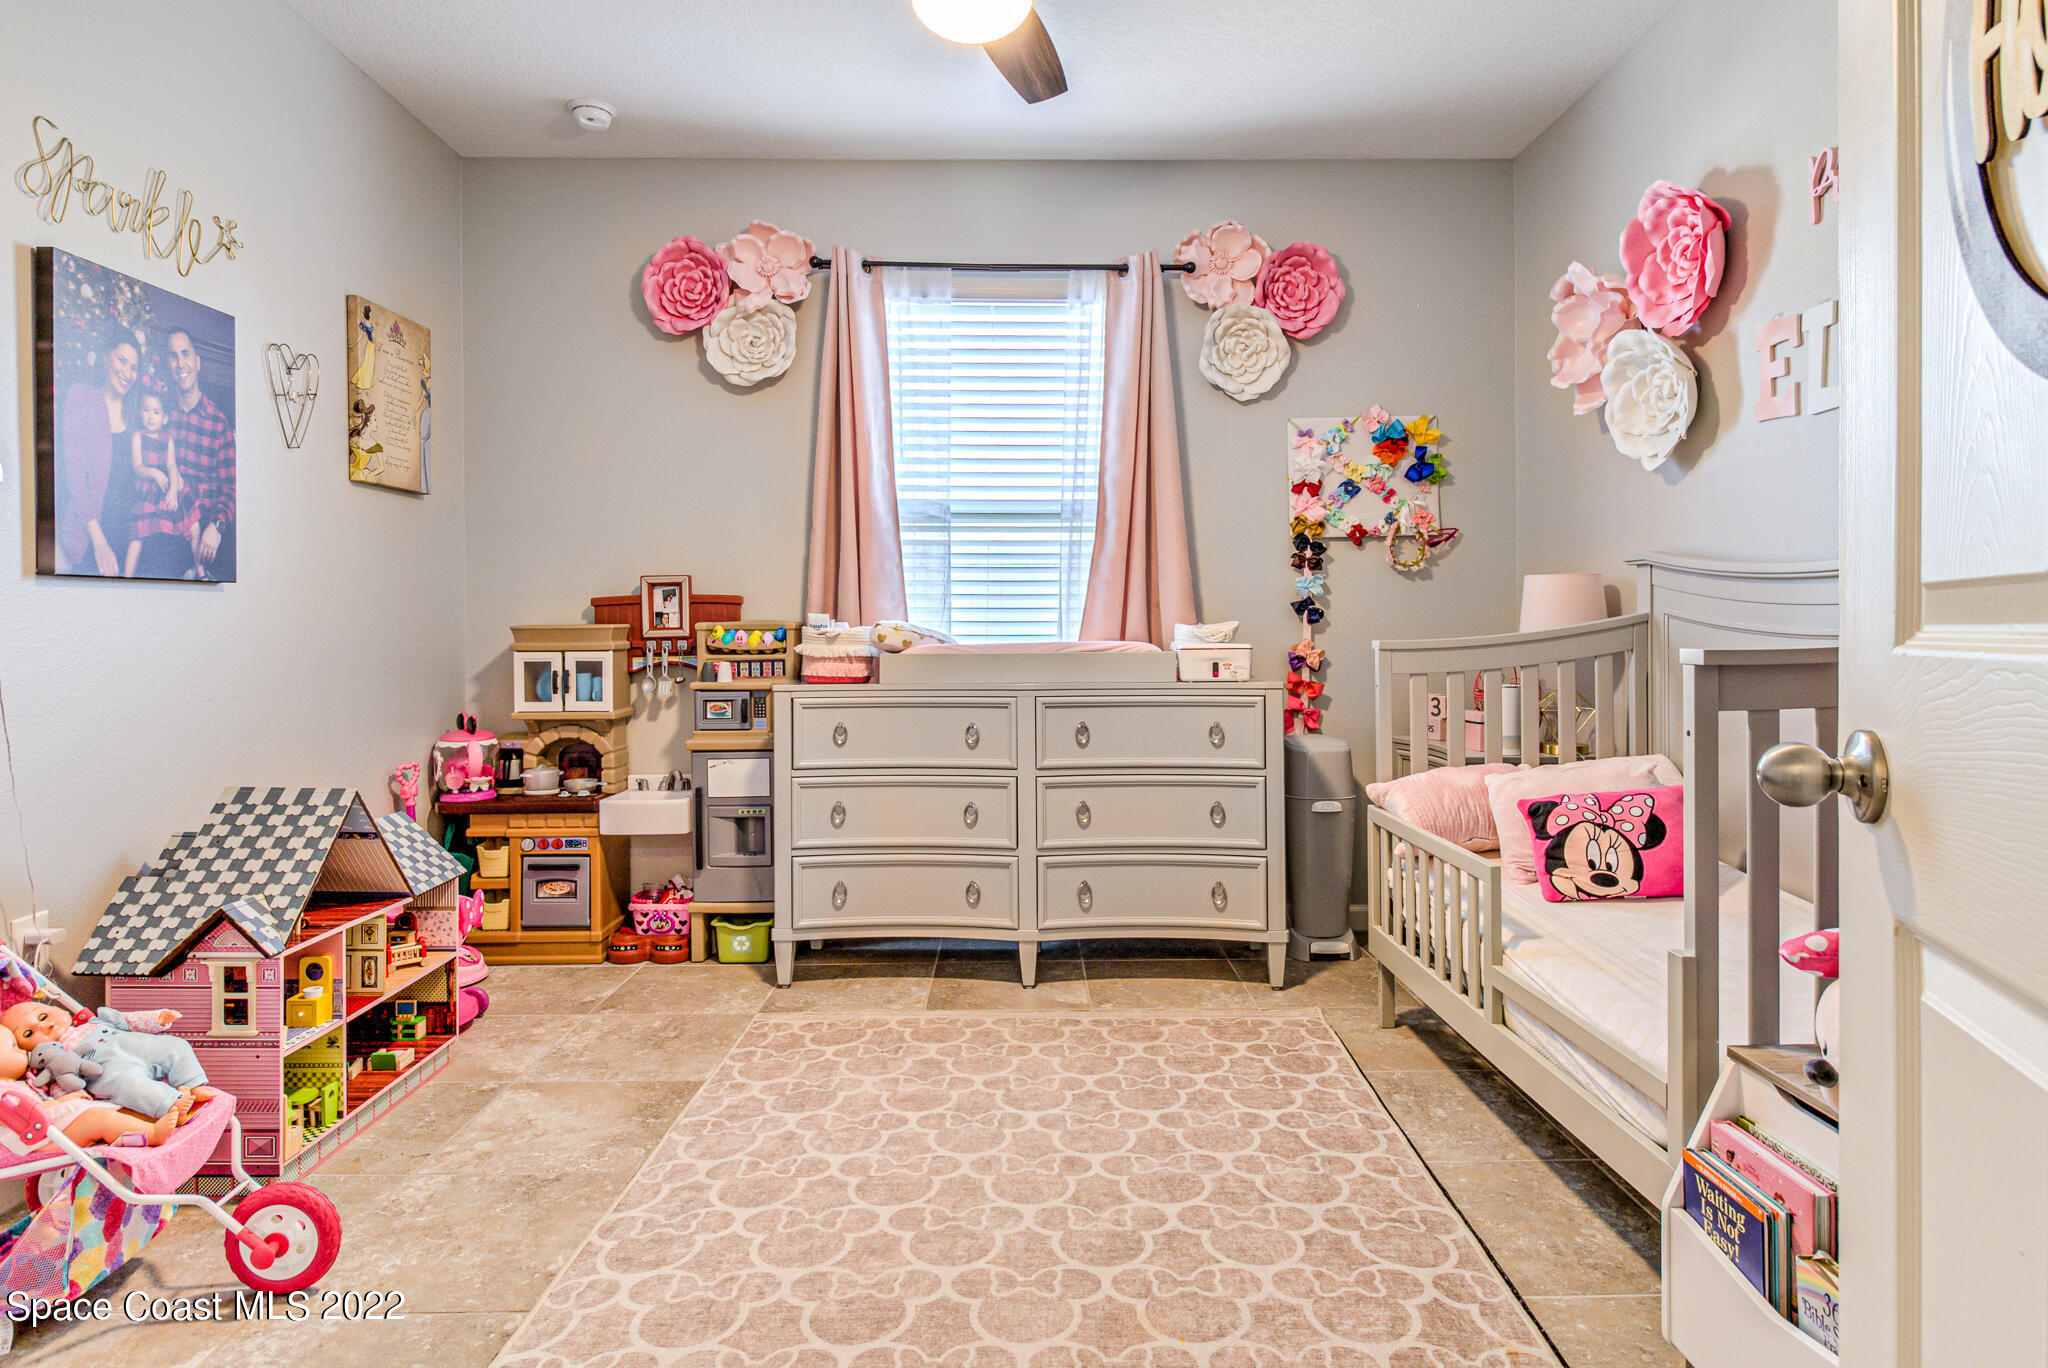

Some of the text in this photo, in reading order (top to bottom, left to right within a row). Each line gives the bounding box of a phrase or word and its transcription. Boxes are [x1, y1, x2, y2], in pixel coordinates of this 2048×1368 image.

[23, 115, 221, 277] Sparkle
[1431, 697, 1441, 717] 3
[1694, 1173, 1746, 1233] Waiting
[1701, 1197, 1740, 1244] Is Not
[1703, 1217, 1740, 1263] Easy!
[1801, 1296, 1831, 1333] Bible
